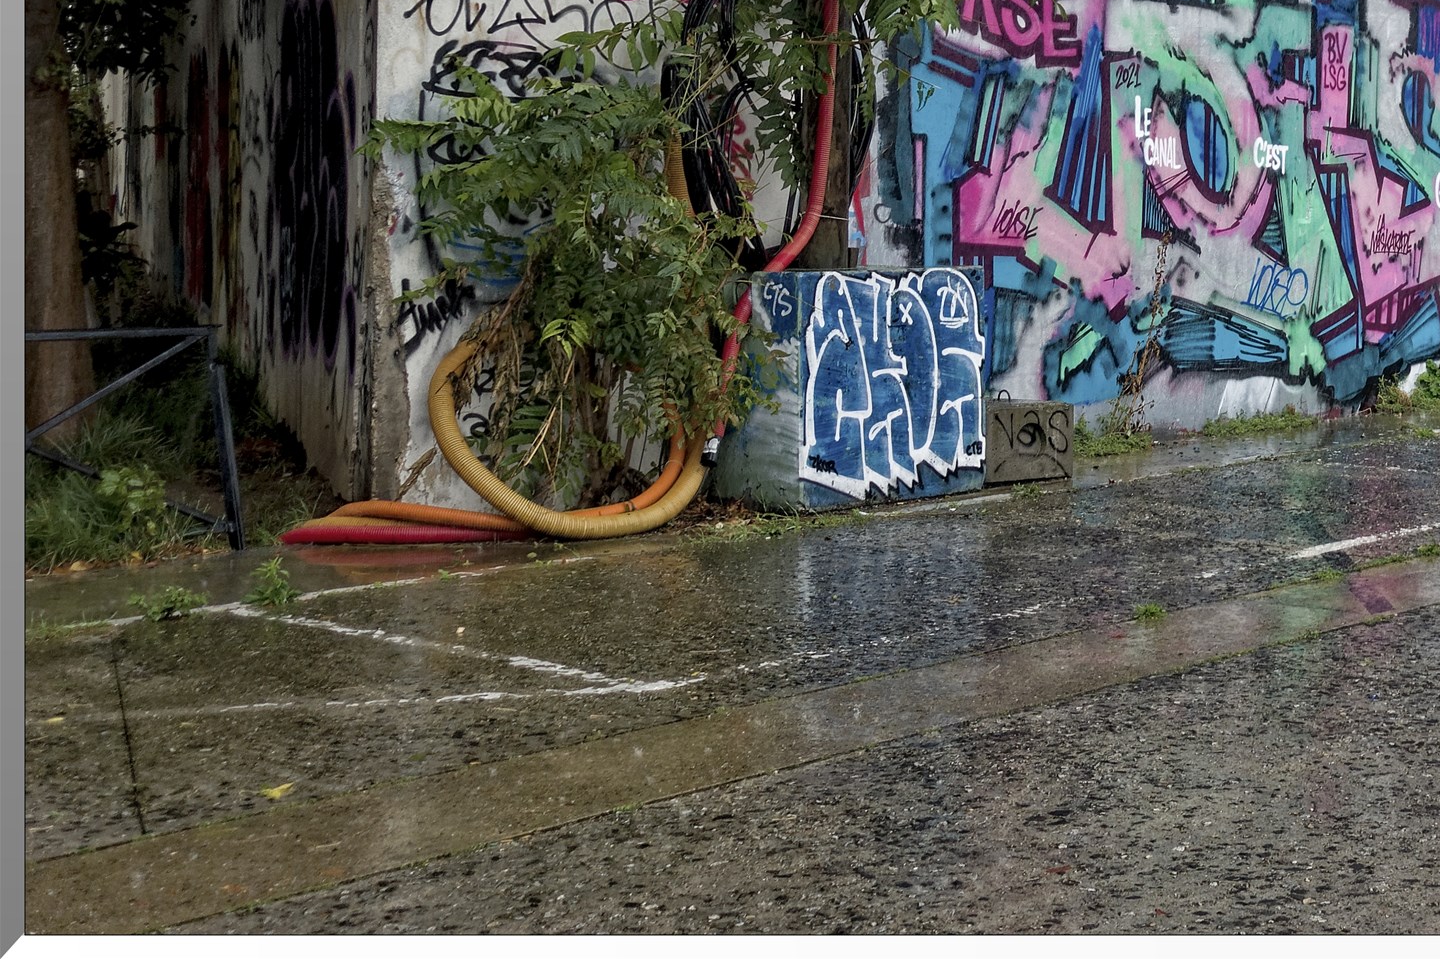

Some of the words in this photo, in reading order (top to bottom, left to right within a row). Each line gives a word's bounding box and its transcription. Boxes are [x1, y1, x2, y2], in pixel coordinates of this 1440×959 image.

[1115, 63, 1142, 90] 2021
[1143, 136, 1181, 170] CANAL
[1253, 137, 1289, 175] C'EST
